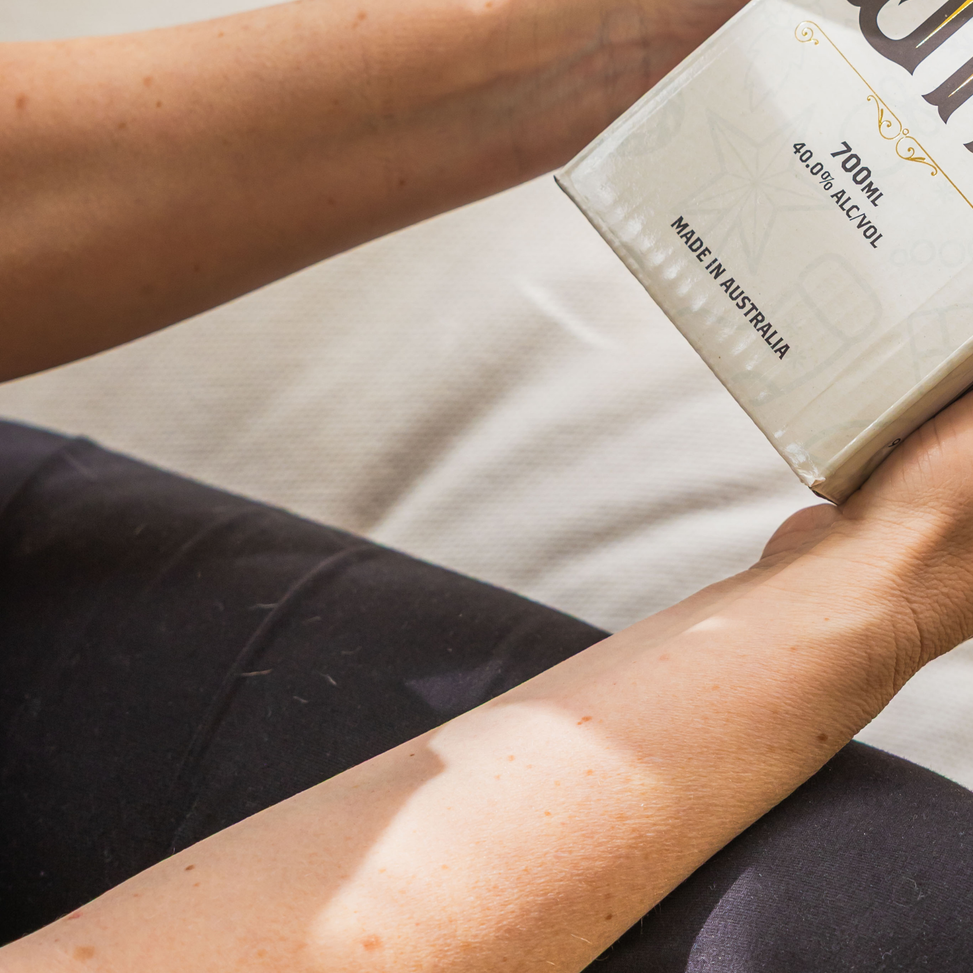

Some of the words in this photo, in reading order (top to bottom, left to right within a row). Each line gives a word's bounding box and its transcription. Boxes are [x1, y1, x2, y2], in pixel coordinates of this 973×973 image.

[792, 142, 835, 191] 40.0%
[830, 189, 885, 249] ALC/VOL
[671, 216, 711, 262] MADE
[705, 258, 726, 280] IN
[719, 277, 790, 360] AUSTRALIA
